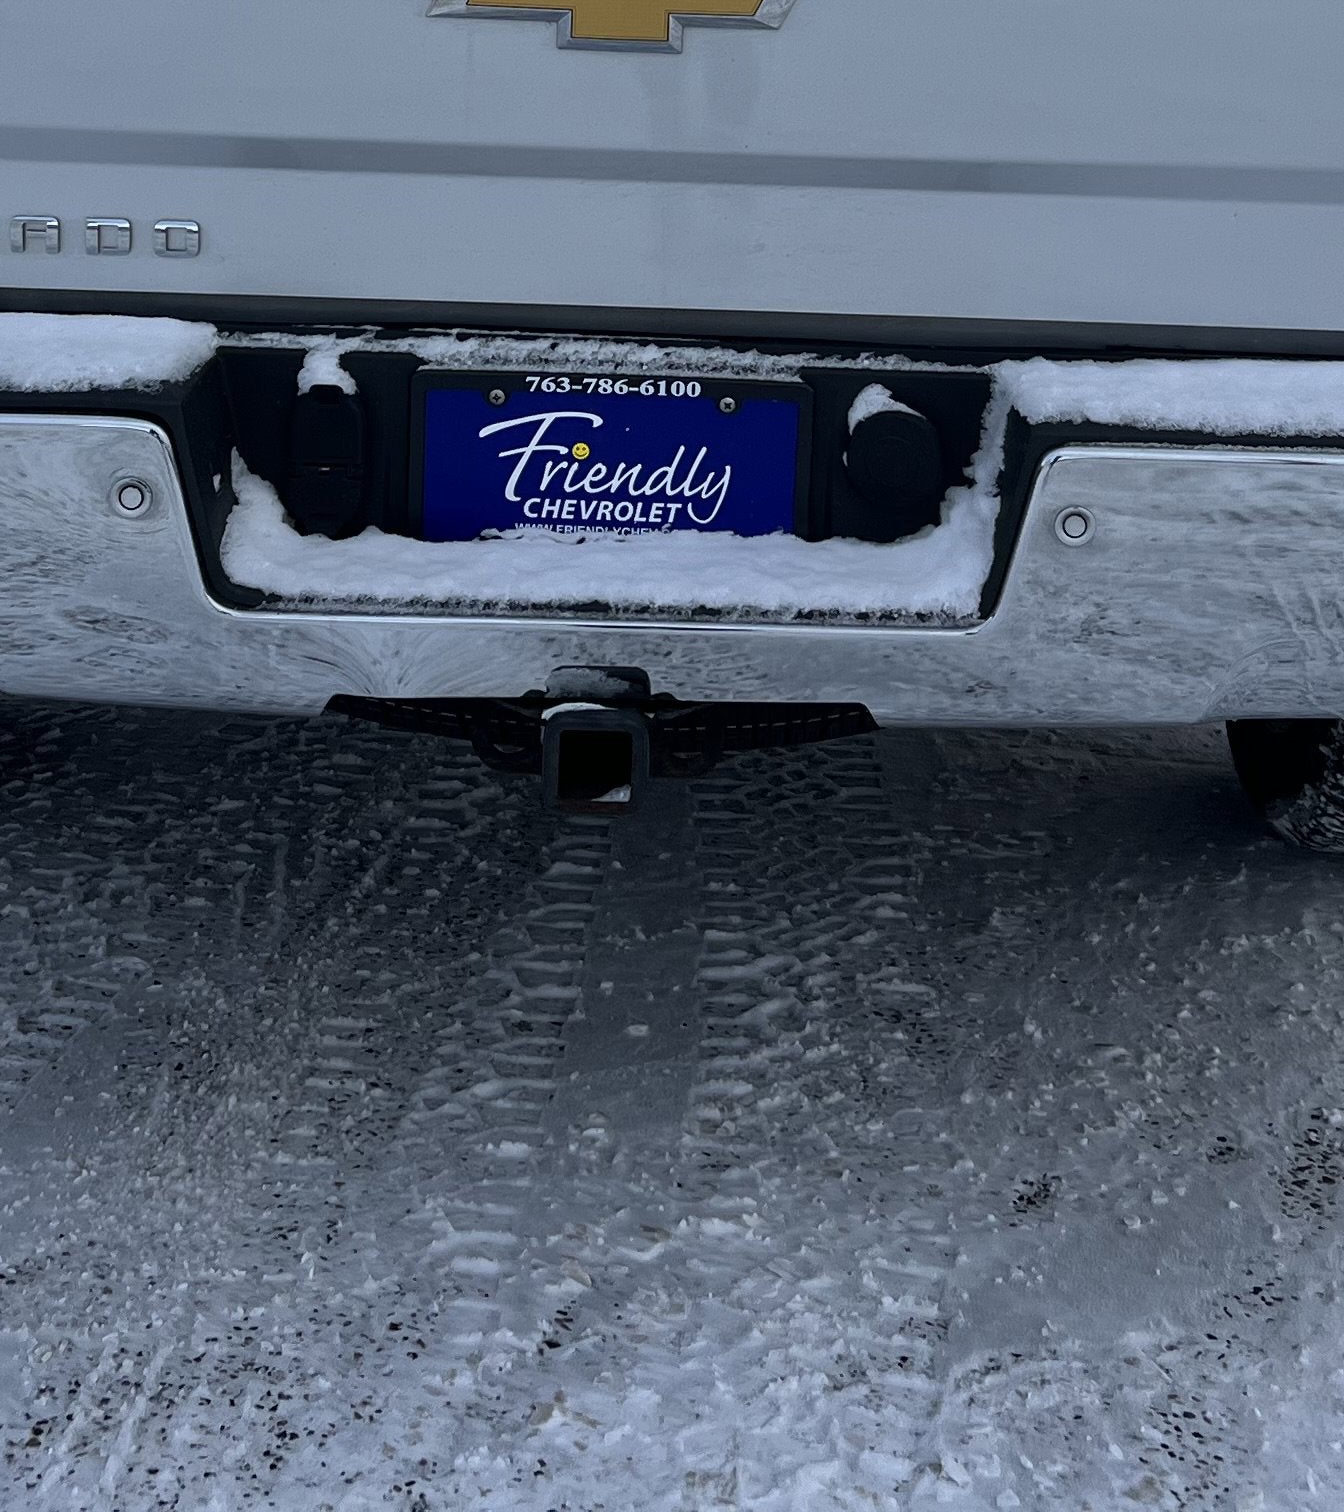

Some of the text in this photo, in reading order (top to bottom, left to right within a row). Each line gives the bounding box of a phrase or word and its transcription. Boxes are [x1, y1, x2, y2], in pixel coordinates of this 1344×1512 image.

[525, 376, 702, 398] 763-786-6100
[478, 411, 731, 524] Friendly
[523, 497, 683, 523] CHEVROLET
